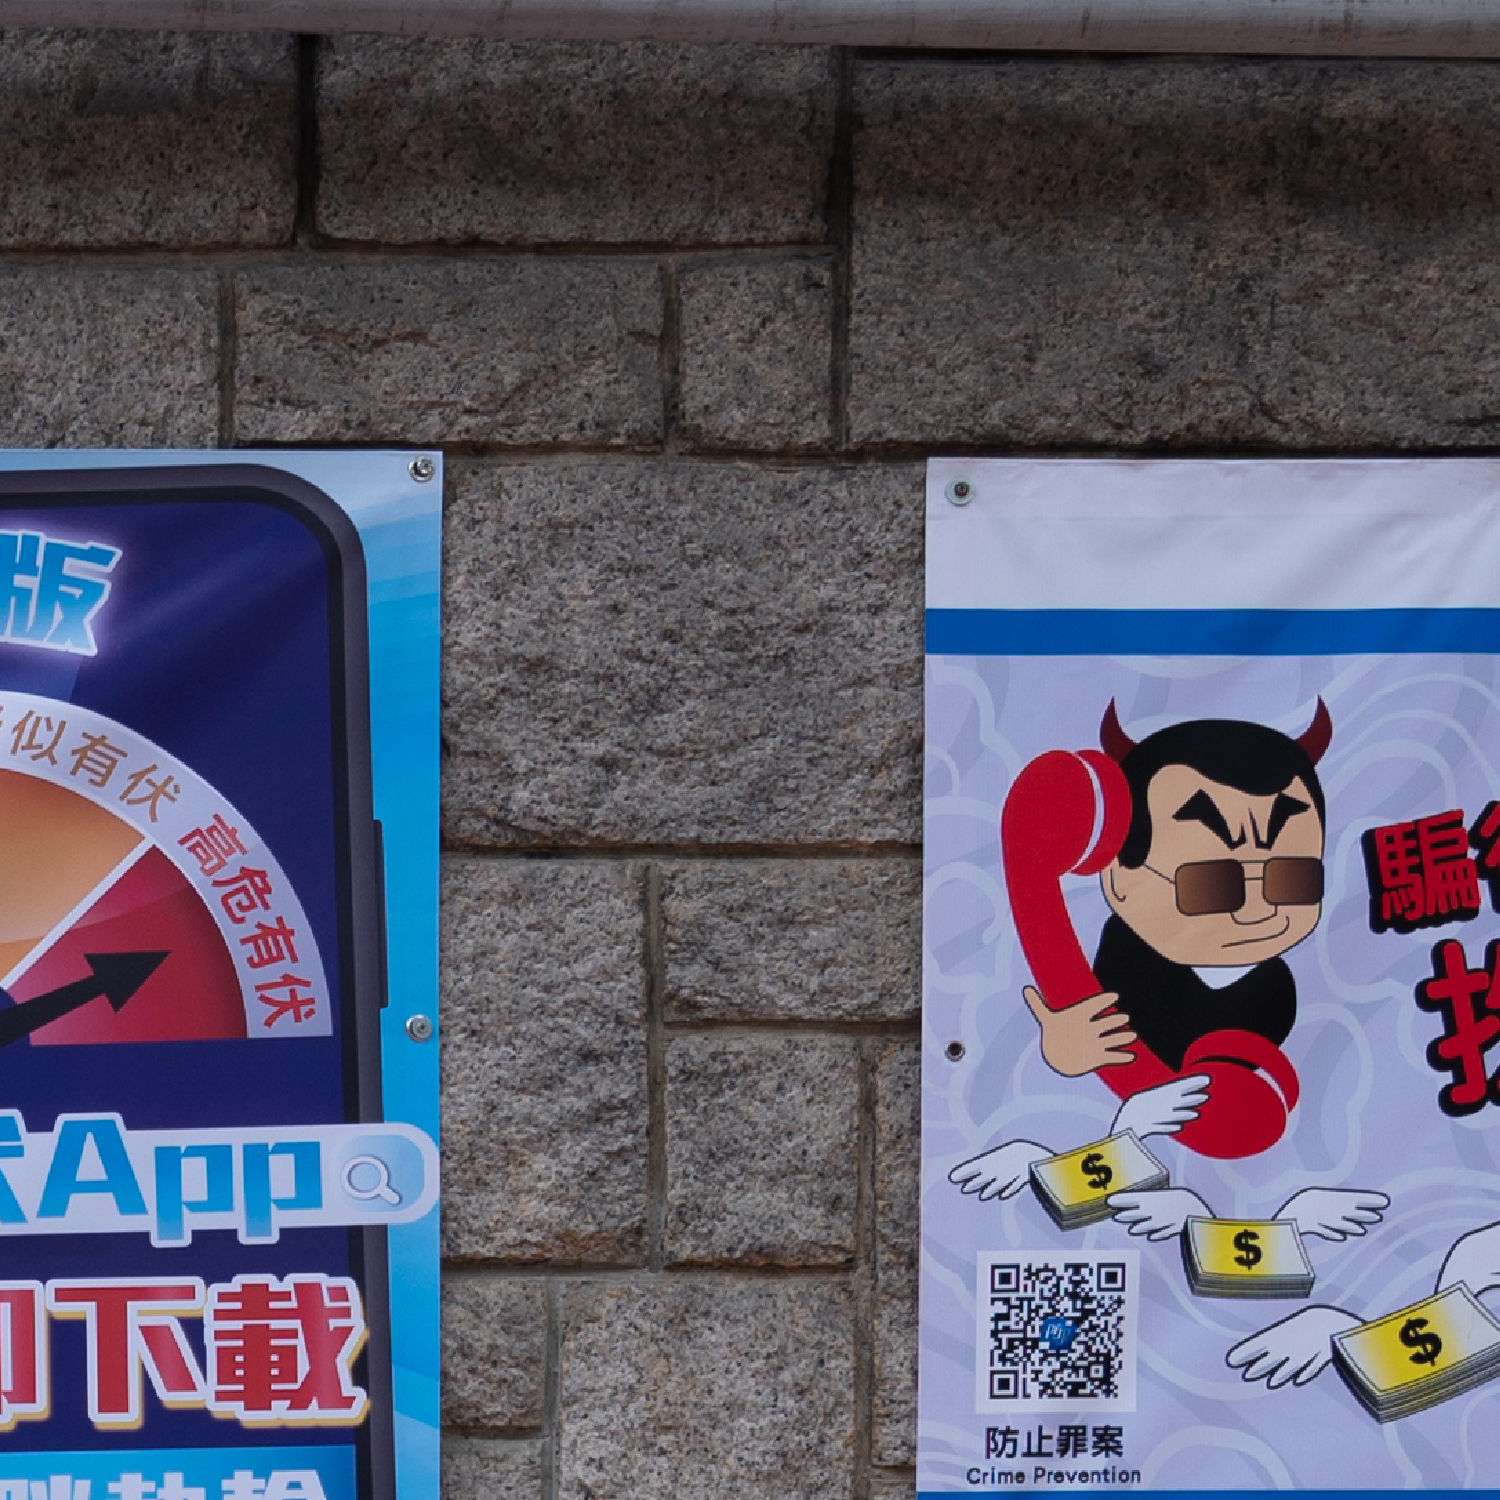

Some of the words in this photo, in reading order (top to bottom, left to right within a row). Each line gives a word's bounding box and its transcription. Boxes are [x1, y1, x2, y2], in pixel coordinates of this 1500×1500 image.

[177, 813, 316, 1028] 高危有伏
[1081, 1153, 1113, 1190] $
[1233, 1229, 1262, 1270] $
[1399, 1317, 1442, 1366] $
[985, 1425, 1123, 1459] 防止罪案
[966, 1466, 1025, 1484] Crime
[1034, 1466, 1141, 1484] Prevention
